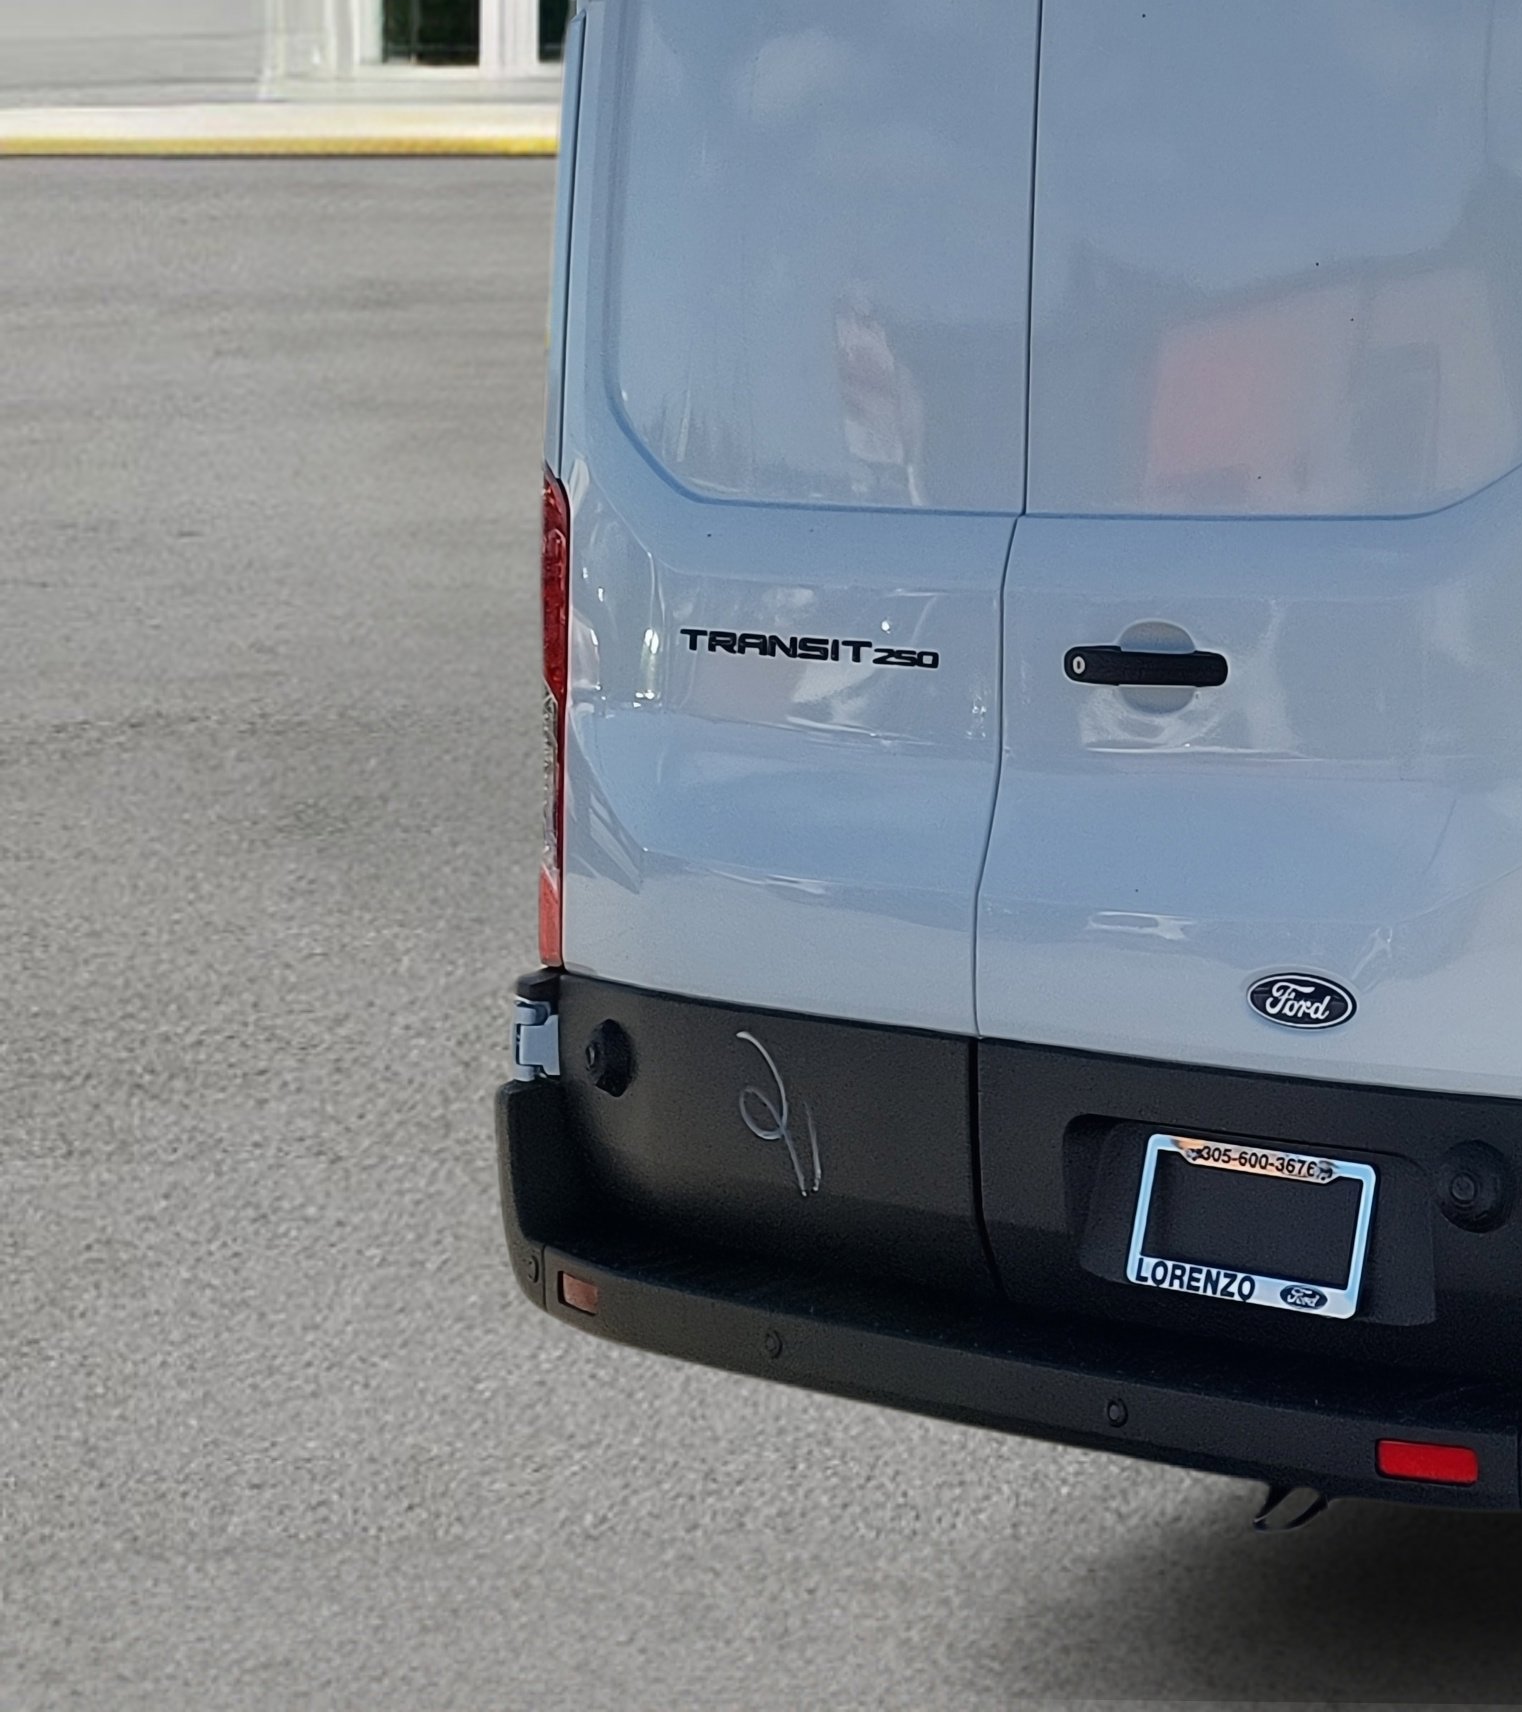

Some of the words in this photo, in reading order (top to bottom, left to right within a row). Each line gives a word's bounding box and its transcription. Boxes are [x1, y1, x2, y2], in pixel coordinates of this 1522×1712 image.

[1265, 981, 1332, 1020] Ford
[1135, 1257, 1256, 1302] LORENZO
[1286, 1286, 1320, 1308] Ford
